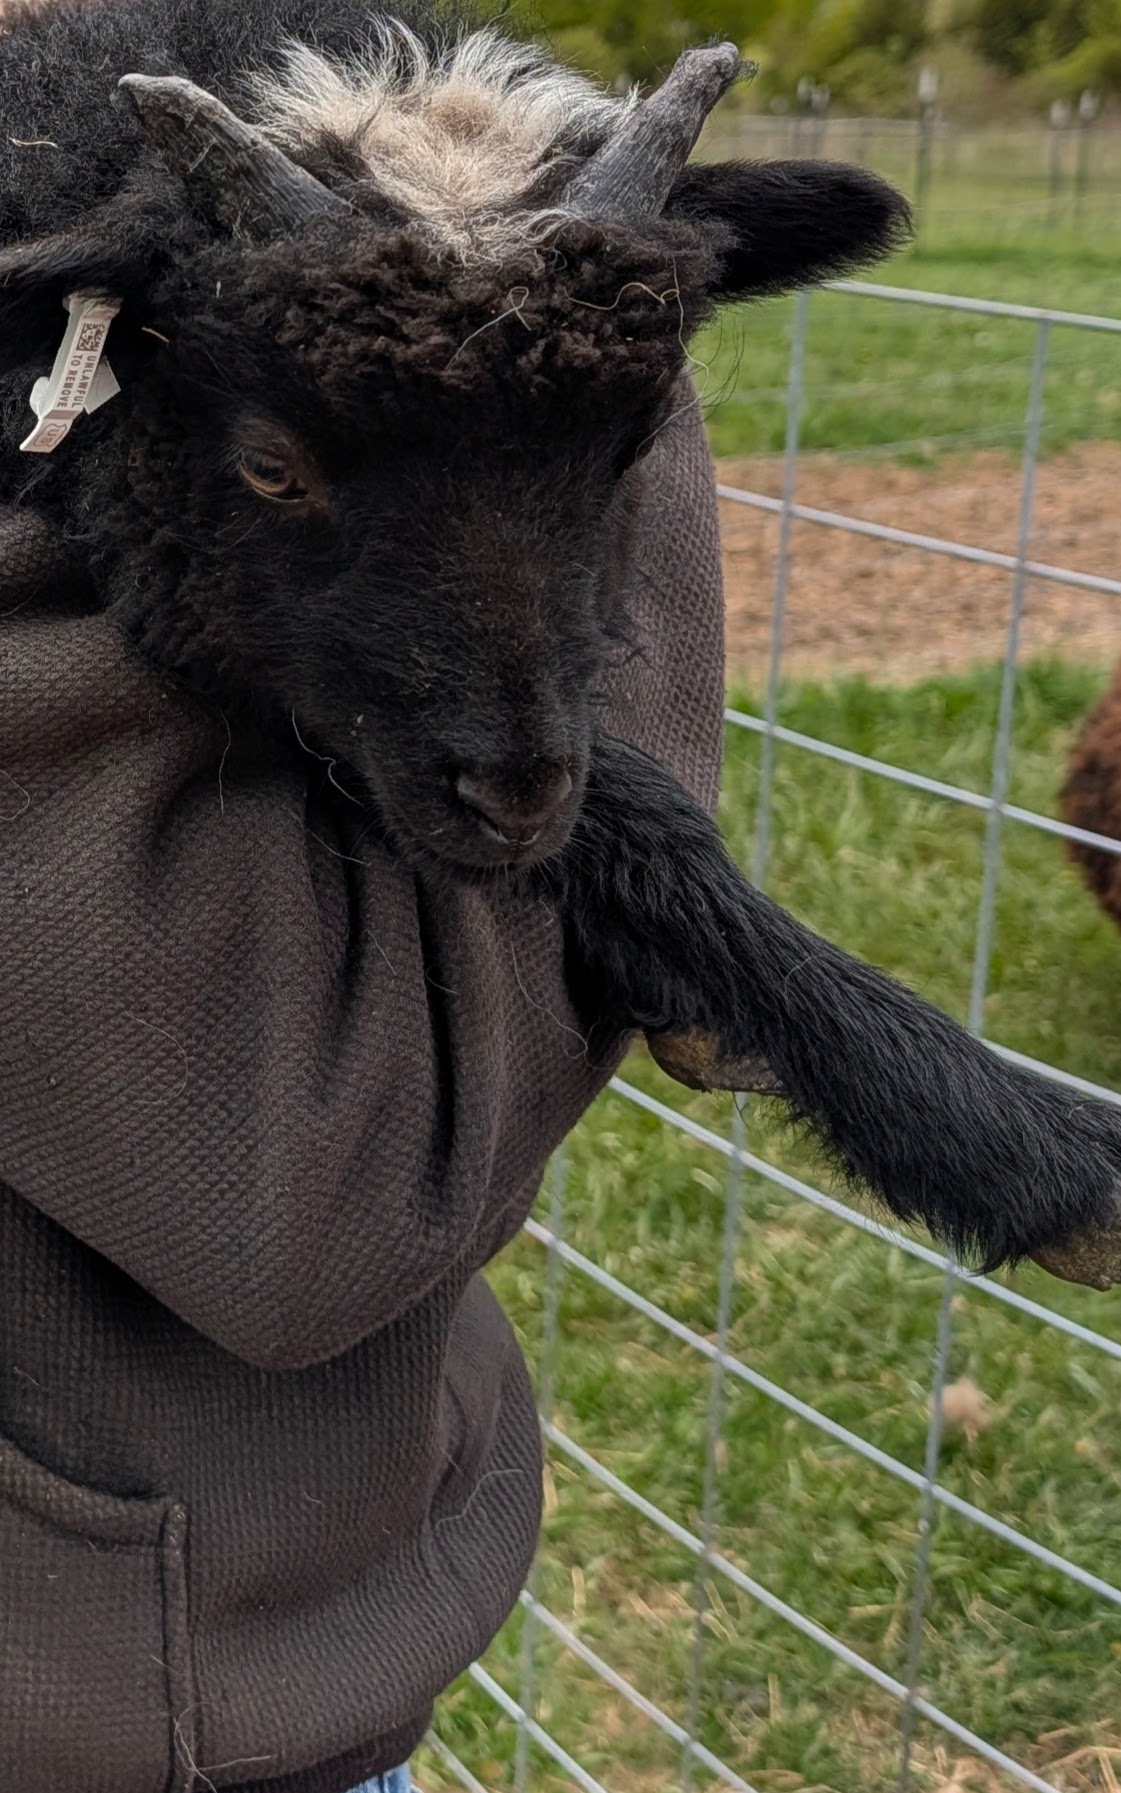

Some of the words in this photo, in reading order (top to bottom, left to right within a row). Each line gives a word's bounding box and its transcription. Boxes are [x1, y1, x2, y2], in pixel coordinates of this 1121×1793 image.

[70, 354, 83, 367] TO
[57, 370, 78, 408] REMOVE
[71, 355, 97, 408] UNLAWFUL
